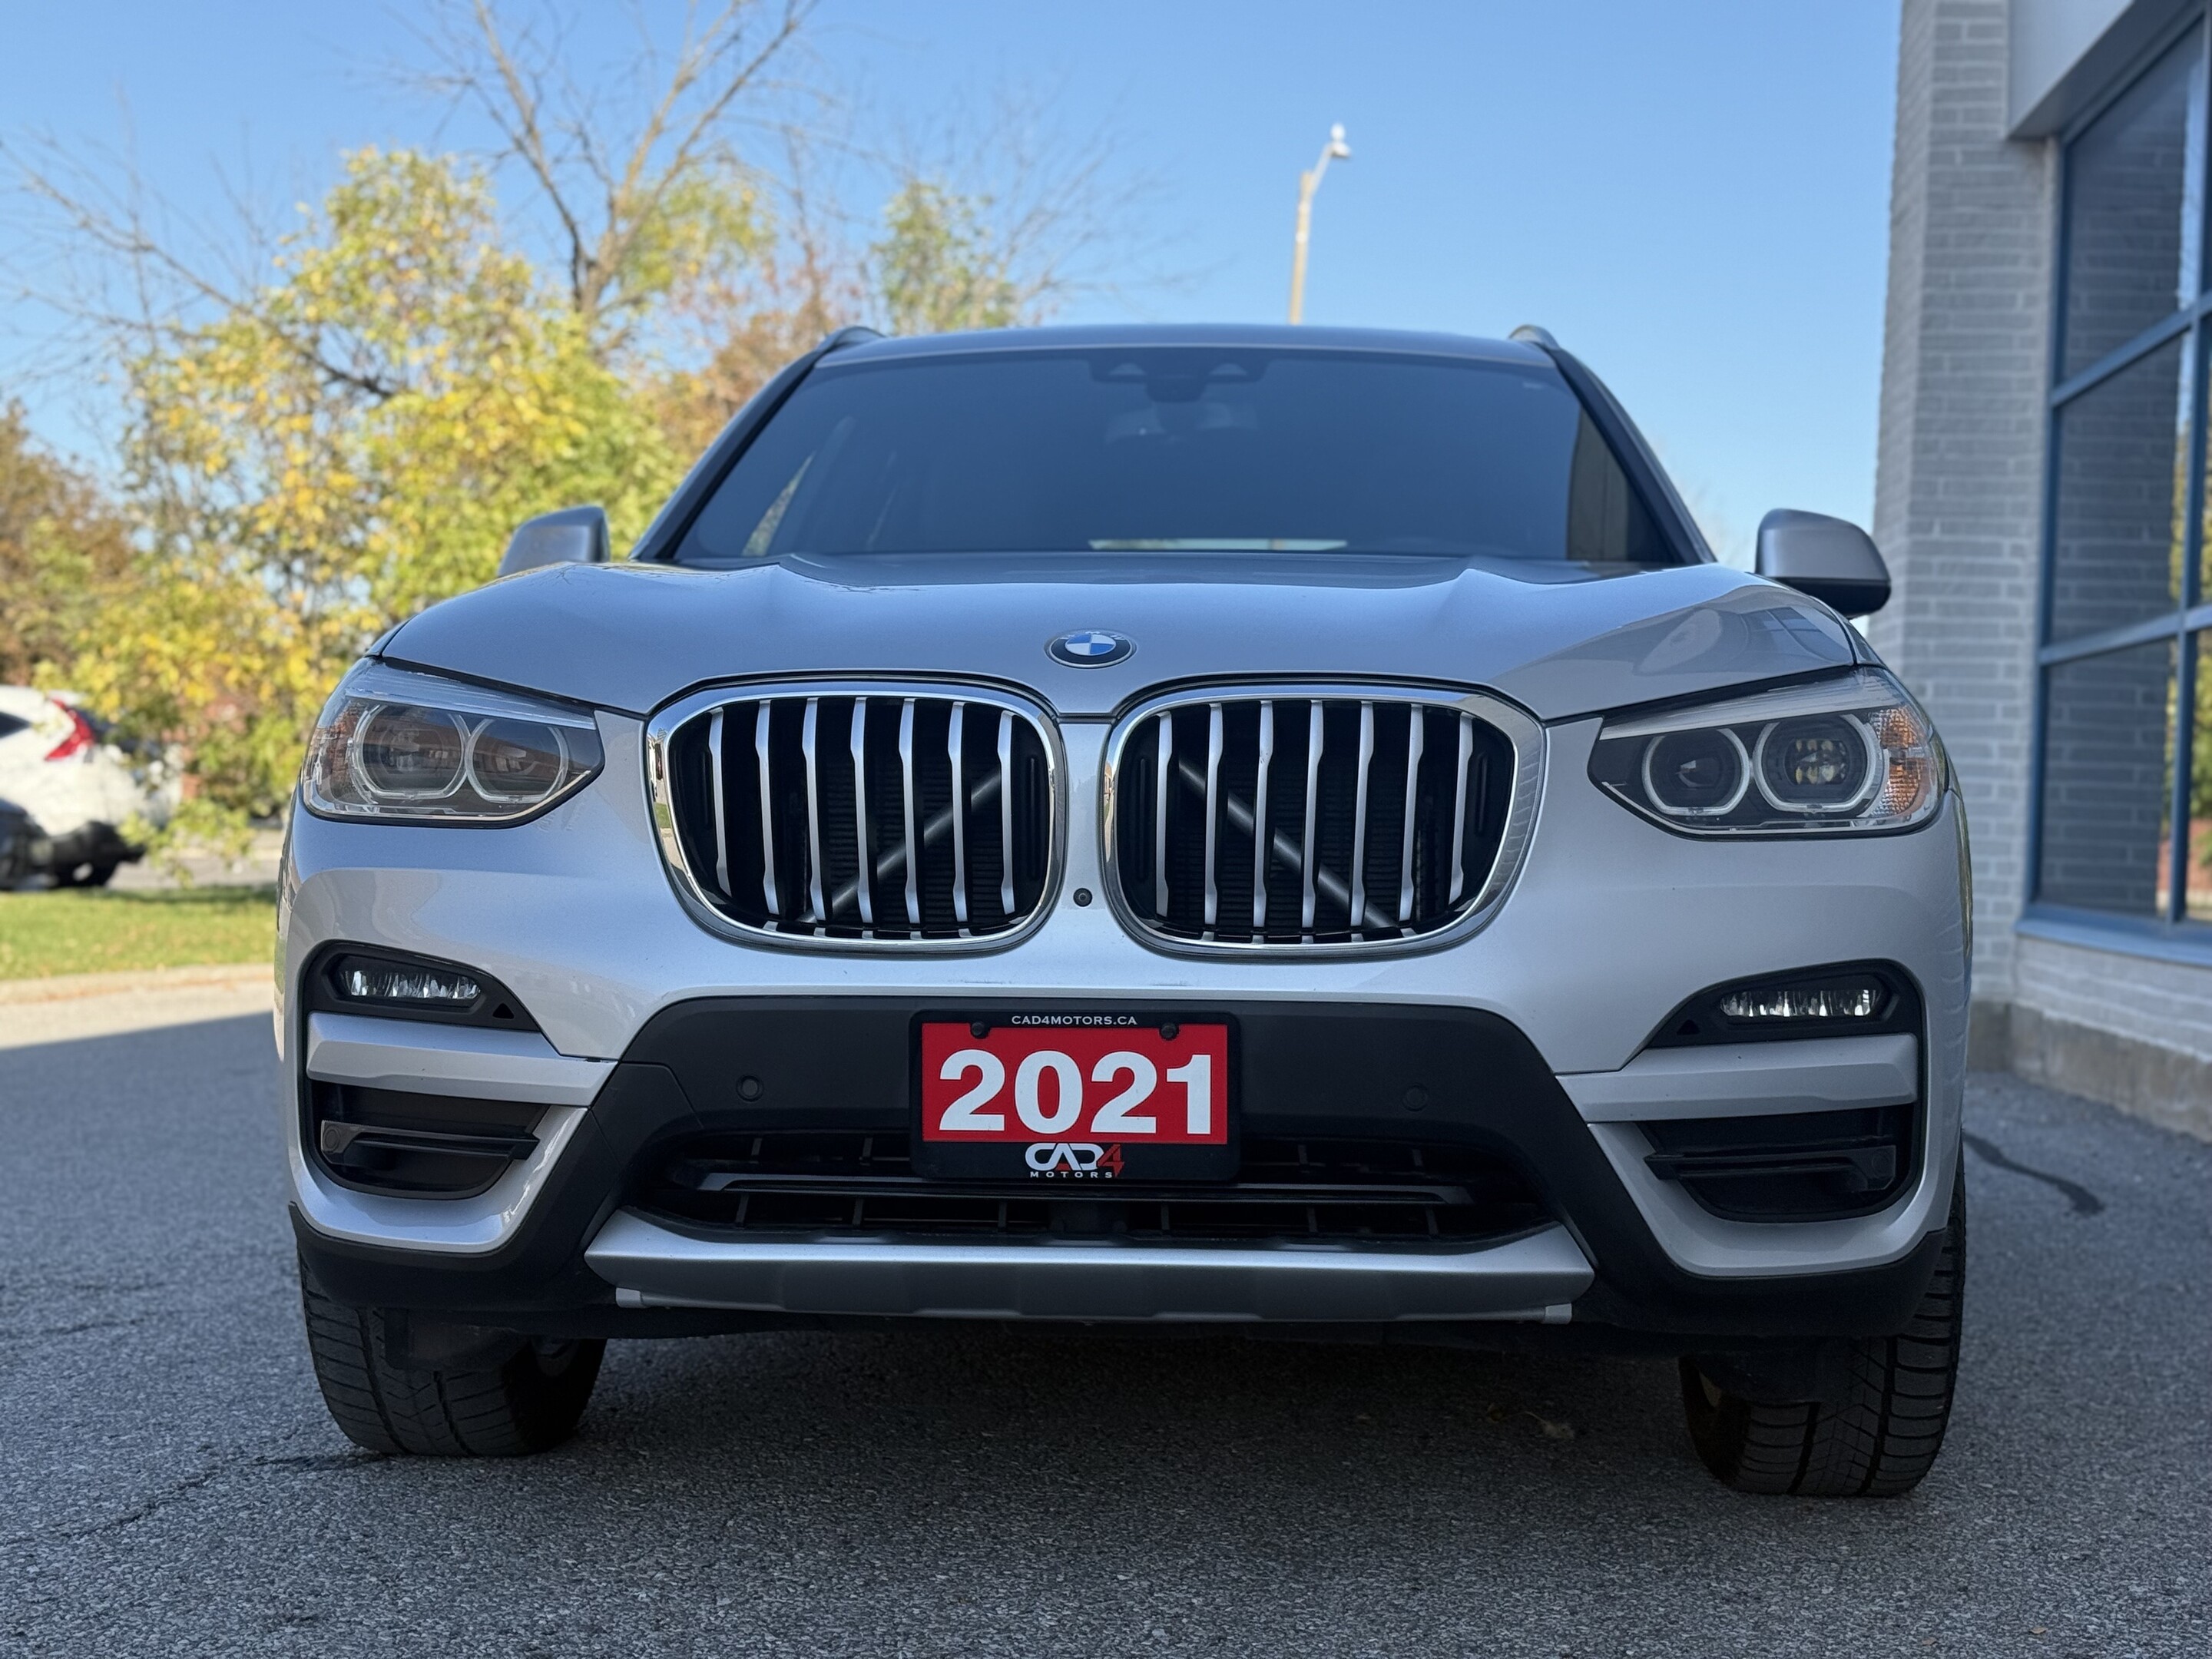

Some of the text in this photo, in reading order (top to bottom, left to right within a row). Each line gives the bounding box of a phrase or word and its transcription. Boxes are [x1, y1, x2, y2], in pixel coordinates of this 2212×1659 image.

[1011, 1015, 1138, 1025] CAD4MOTORS.CA
[939, 1048, 1211, 1135] 2021
[1025, 1142, 1125, 1177] CAD4
